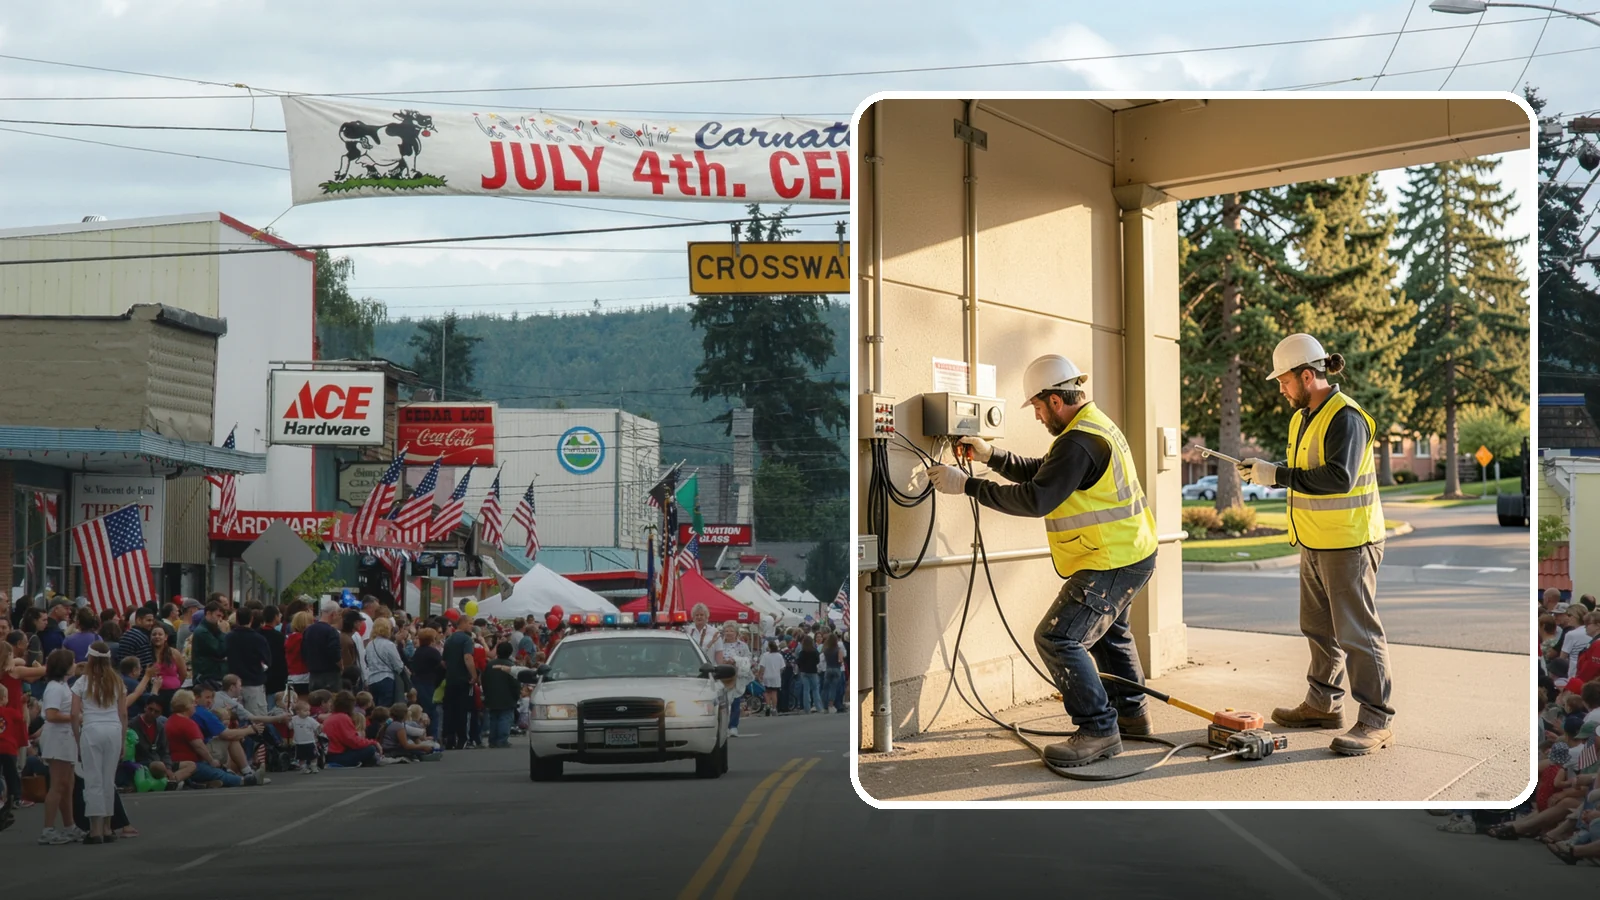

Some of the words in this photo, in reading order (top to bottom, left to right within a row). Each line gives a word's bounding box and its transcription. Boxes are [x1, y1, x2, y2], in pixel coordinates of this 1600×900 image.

[481, 141, 605, 192] JULY
[632, 150, 746, 198] 4th.
[697, 254, 850, 280] CROSSWA
[282, 380, 374, 420] ACE
[405, 409, 453, 422] CEDAR
[283, 421, 371, 437] Hardware
[96, 485, 124, 495] Vincent
[126, 486, 135, 495] de
[137, 486, 155, 495] Paul
[213, 516, 330, 535] HARDARE
[688, 526, 741, 535] CRNATION
[699, 535, 730, 543] GLASS
